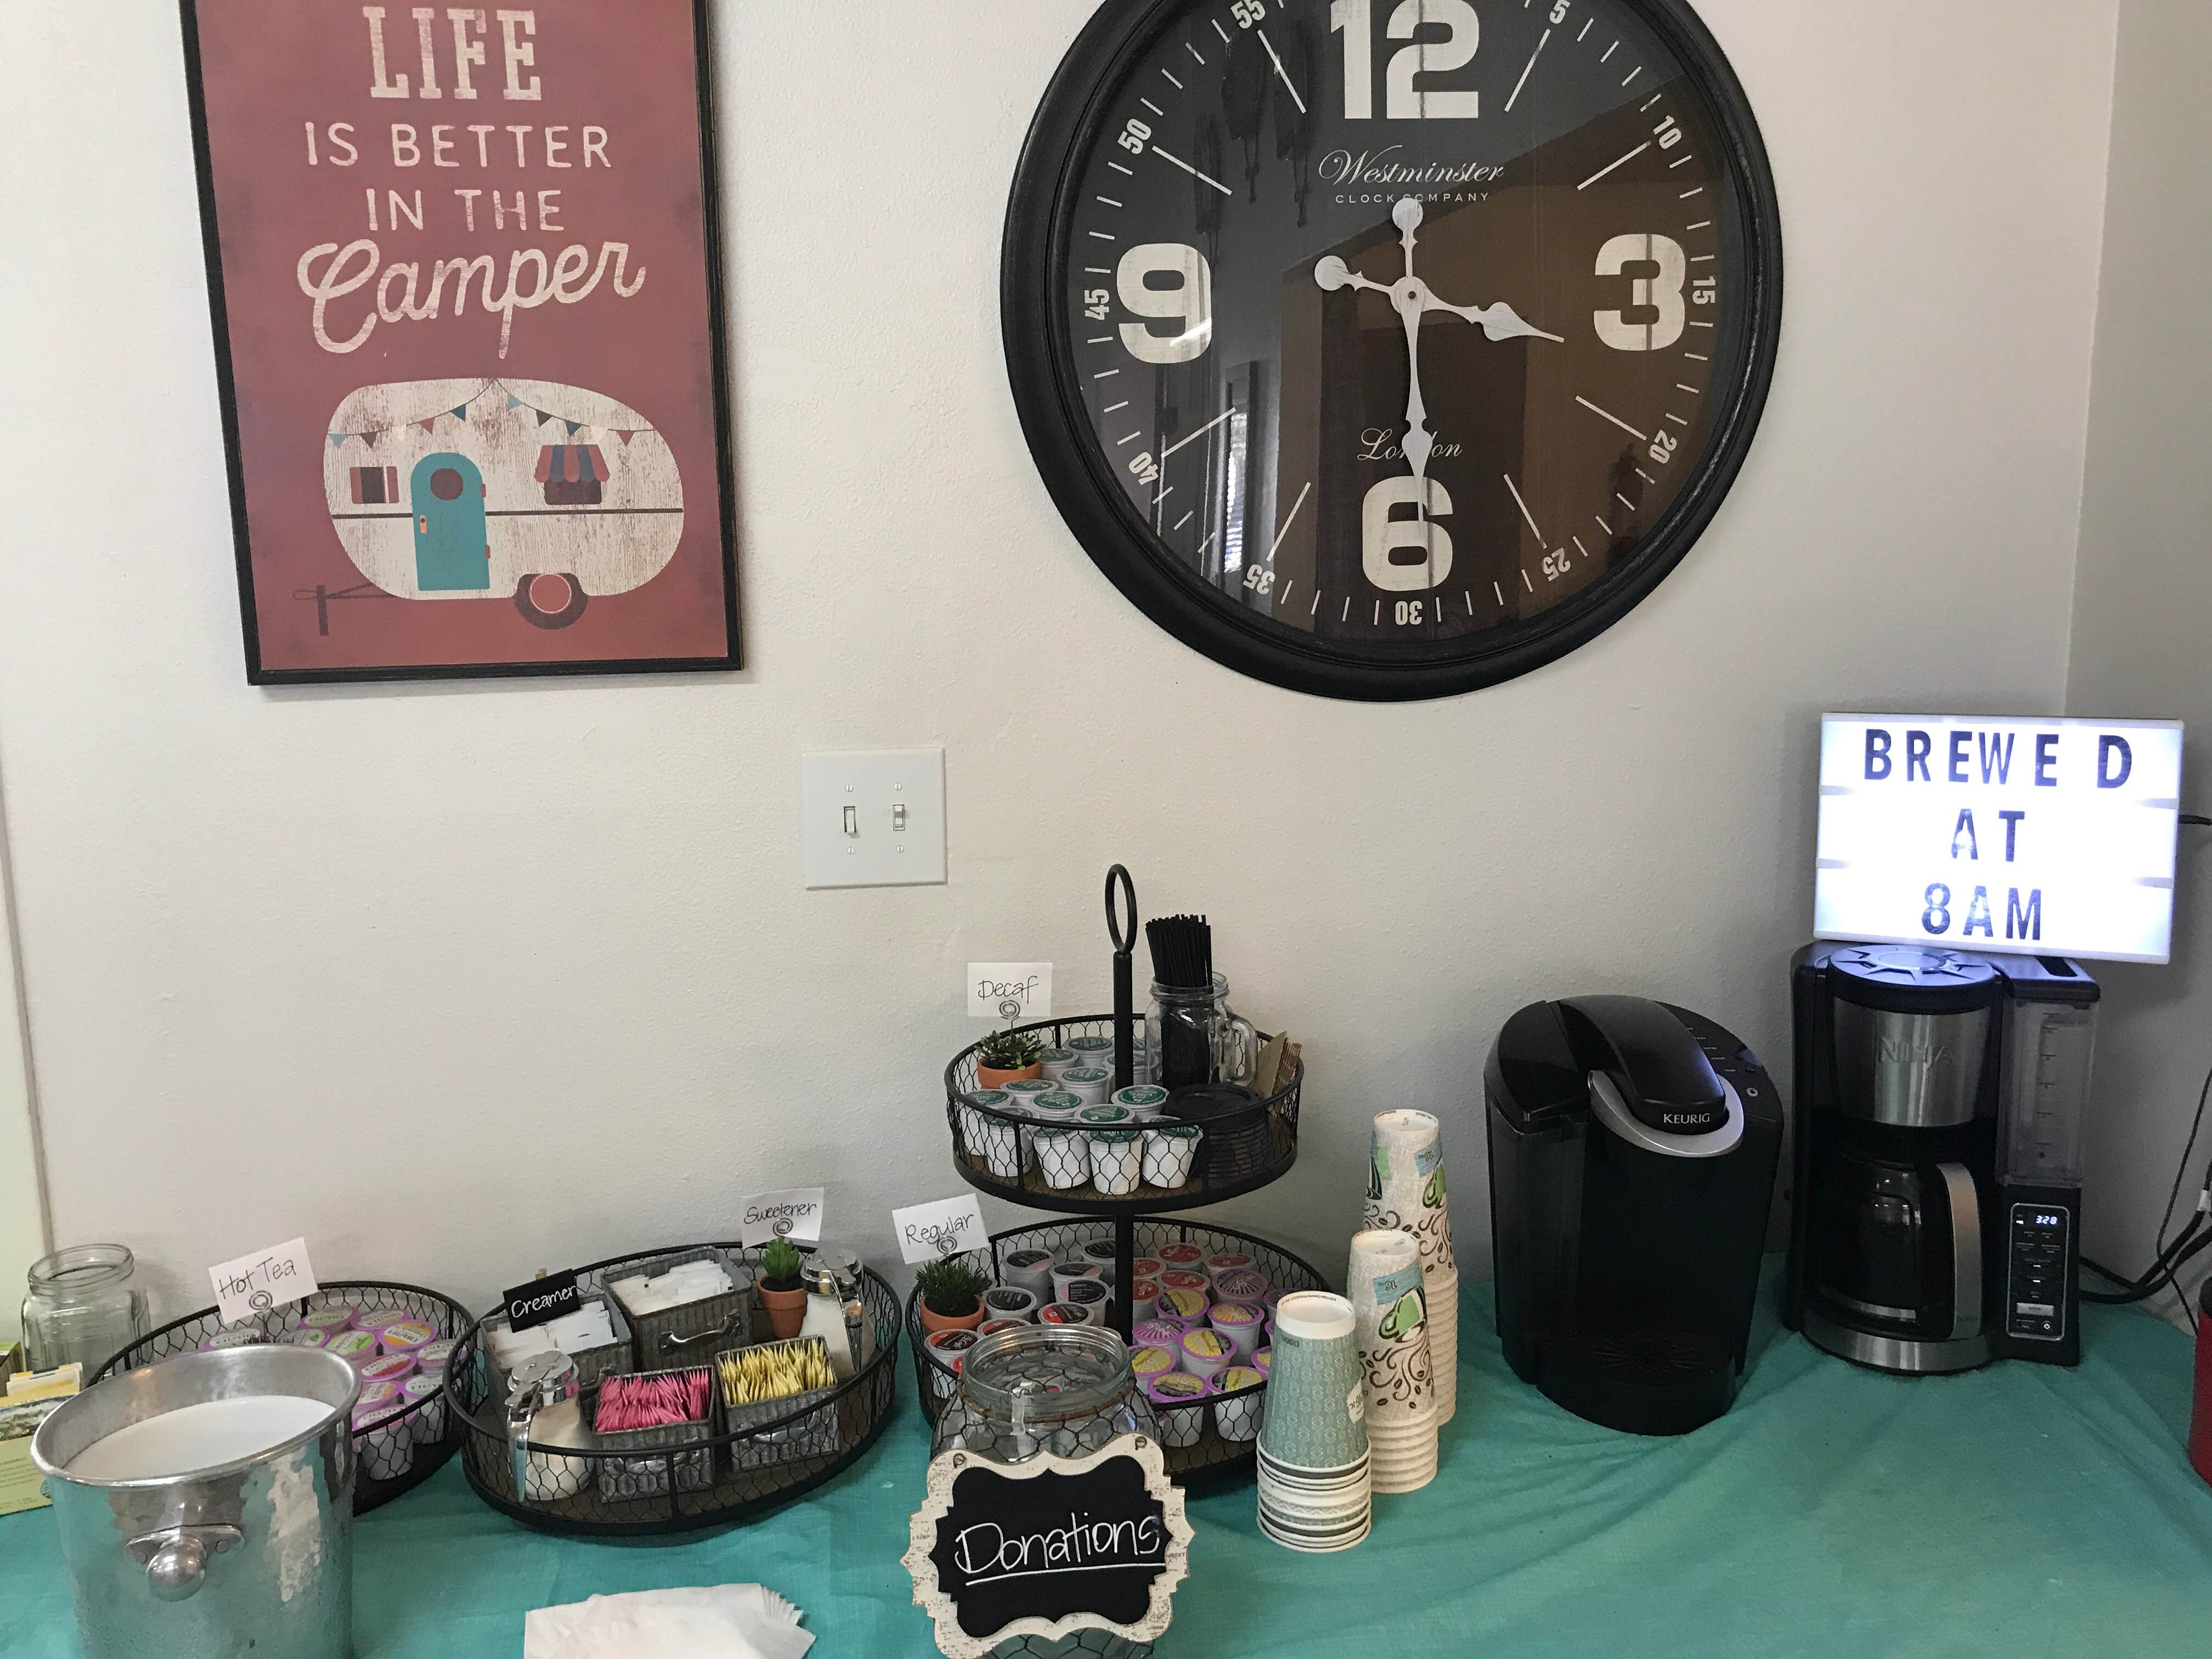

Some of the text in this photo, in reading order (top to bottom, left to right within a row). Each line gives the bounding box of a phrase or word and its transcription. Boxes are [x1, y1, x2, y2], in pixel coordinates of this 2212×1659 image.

[1231, 0, 1265, 29] 55
[1549, 0, 1570, 24] 5
[363, 6, 541, 101] LIFE
[1330, 0, 1479, 119] 12
[306, 122, 611, 168] IS BETTER
[1118, 119, 1152, 154] 50
[1652, 115, 1682, 149] 10
[1319, 145, 1504, 185] Westminster
[366, 188, 565, 231] IN THE
[1336, 194, 1394, 203] CLOCK
[297, 239, 646, 359] Camper
[1085, 289, 1110, 320] 45
[1116, 243, 1211, 363] 9
[1594, 234, 1685, 351] 3
[1692, 276, 1716, 304] 15
[1650, 430, 1677, 464] 20
[1128, 452, 1158, 484] 40
[1362, 476, 1453, 591] 6
[1243, 563, 1275, 595] 35
[1543, 548, 1570, 582] 25
[1395, 601, 1422, 625] 30
[1864, 729, 2132, 788] BREWED
[1951, 809, 2025, 862] AT
[1921, 883, 2041, 940] 8AM
[978, 975, 1039, 1003] Decaf
[1877, 1036, 1954, 1068] NINJA
[1663, 1113, 1710, 1124] KEURIG
[743, 1202, 817, 1224] Sweetener
[904, 1212, 974, 1245] Regular
[2035, 1215, 2058, 1224] 3:28
[219, 1257, 297, 1300] Hot Tea
[511, 1283, 577, 1318] Creamer
[954, 1512, 1160, 1573] Donations
